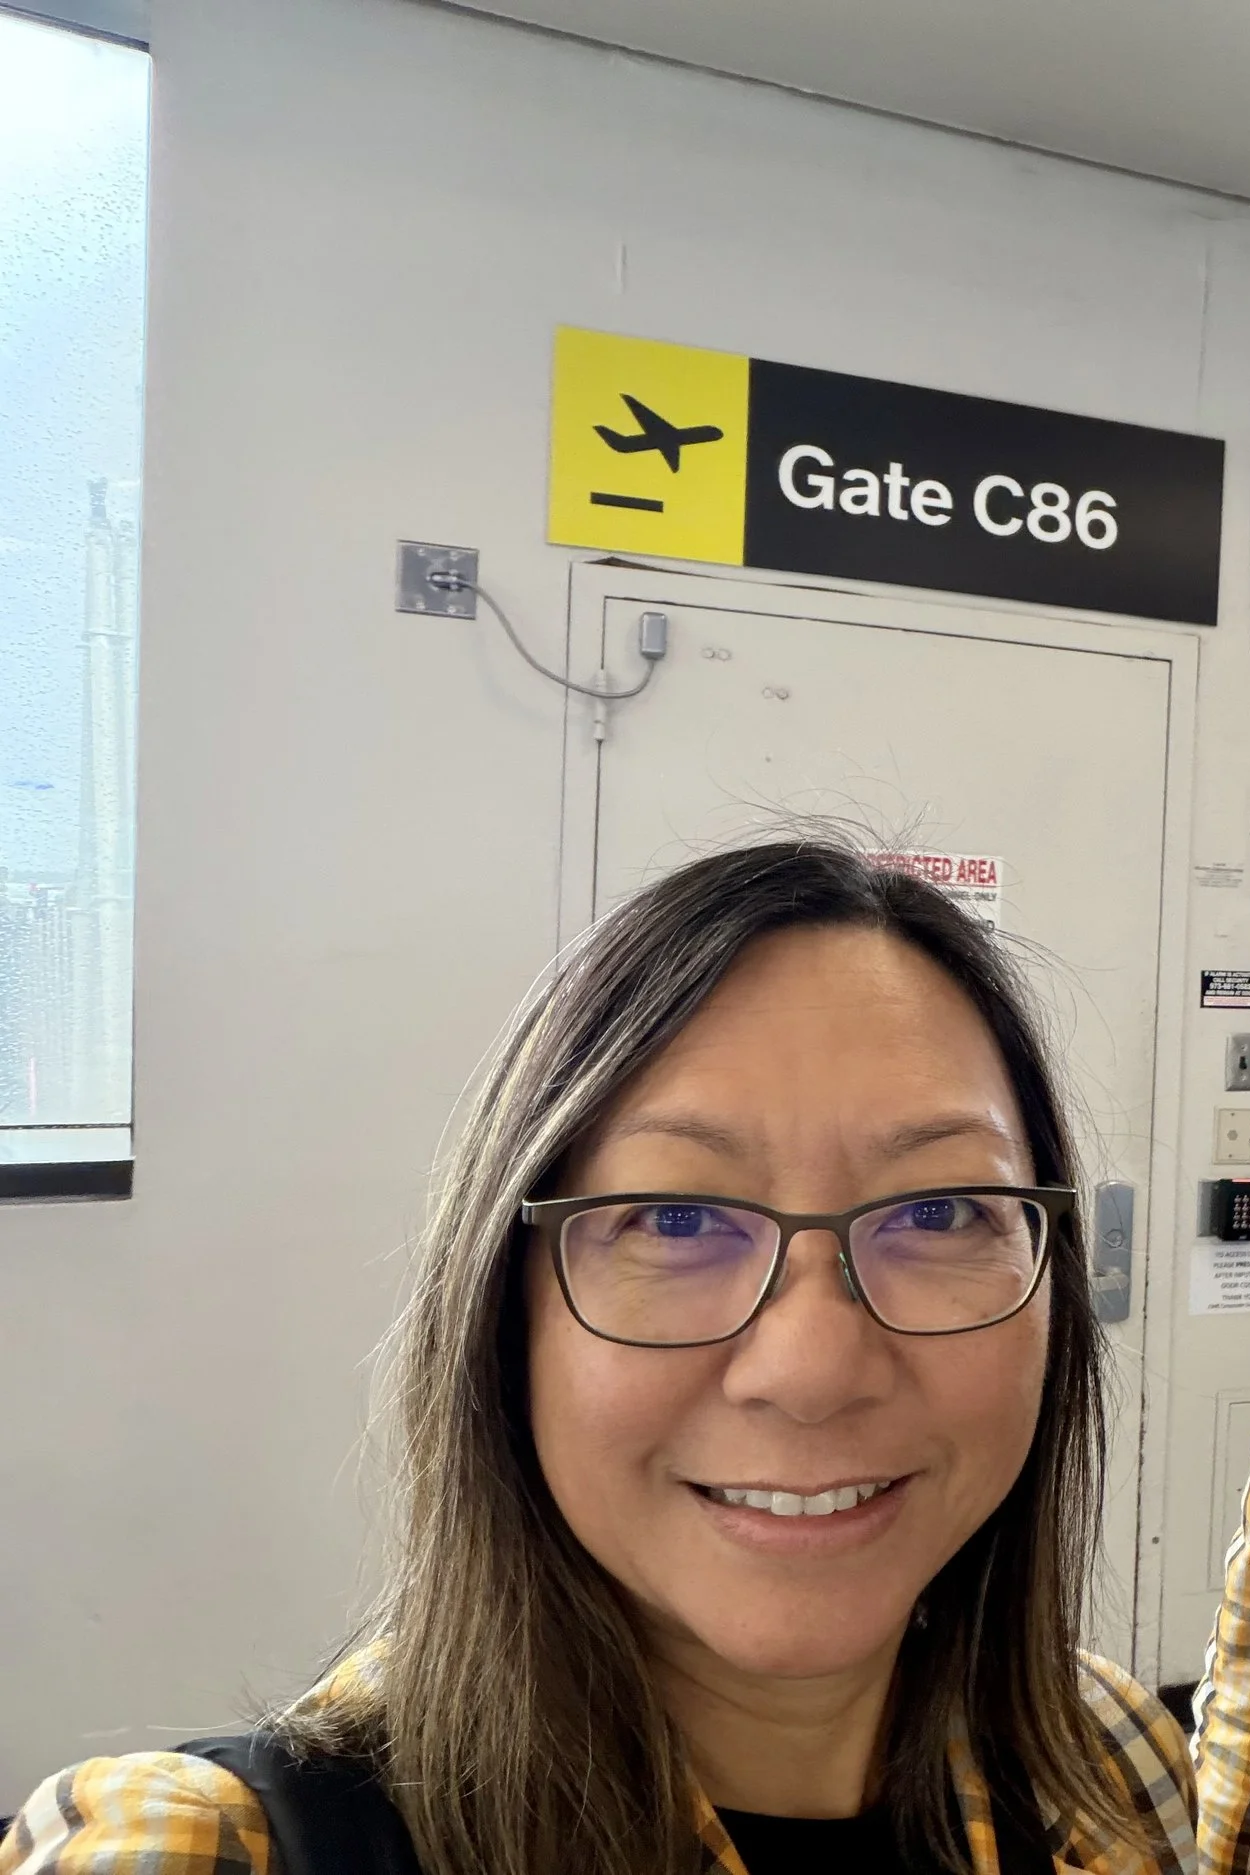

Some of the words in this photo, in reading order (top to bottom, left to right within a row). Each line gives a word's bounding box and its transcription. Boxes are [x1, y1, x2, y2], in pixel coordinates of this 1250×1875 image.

[778, 444, 953, 526] Gate
[973, 474, 1118, 550] C86
[957, 858, 997, 884] AREA
